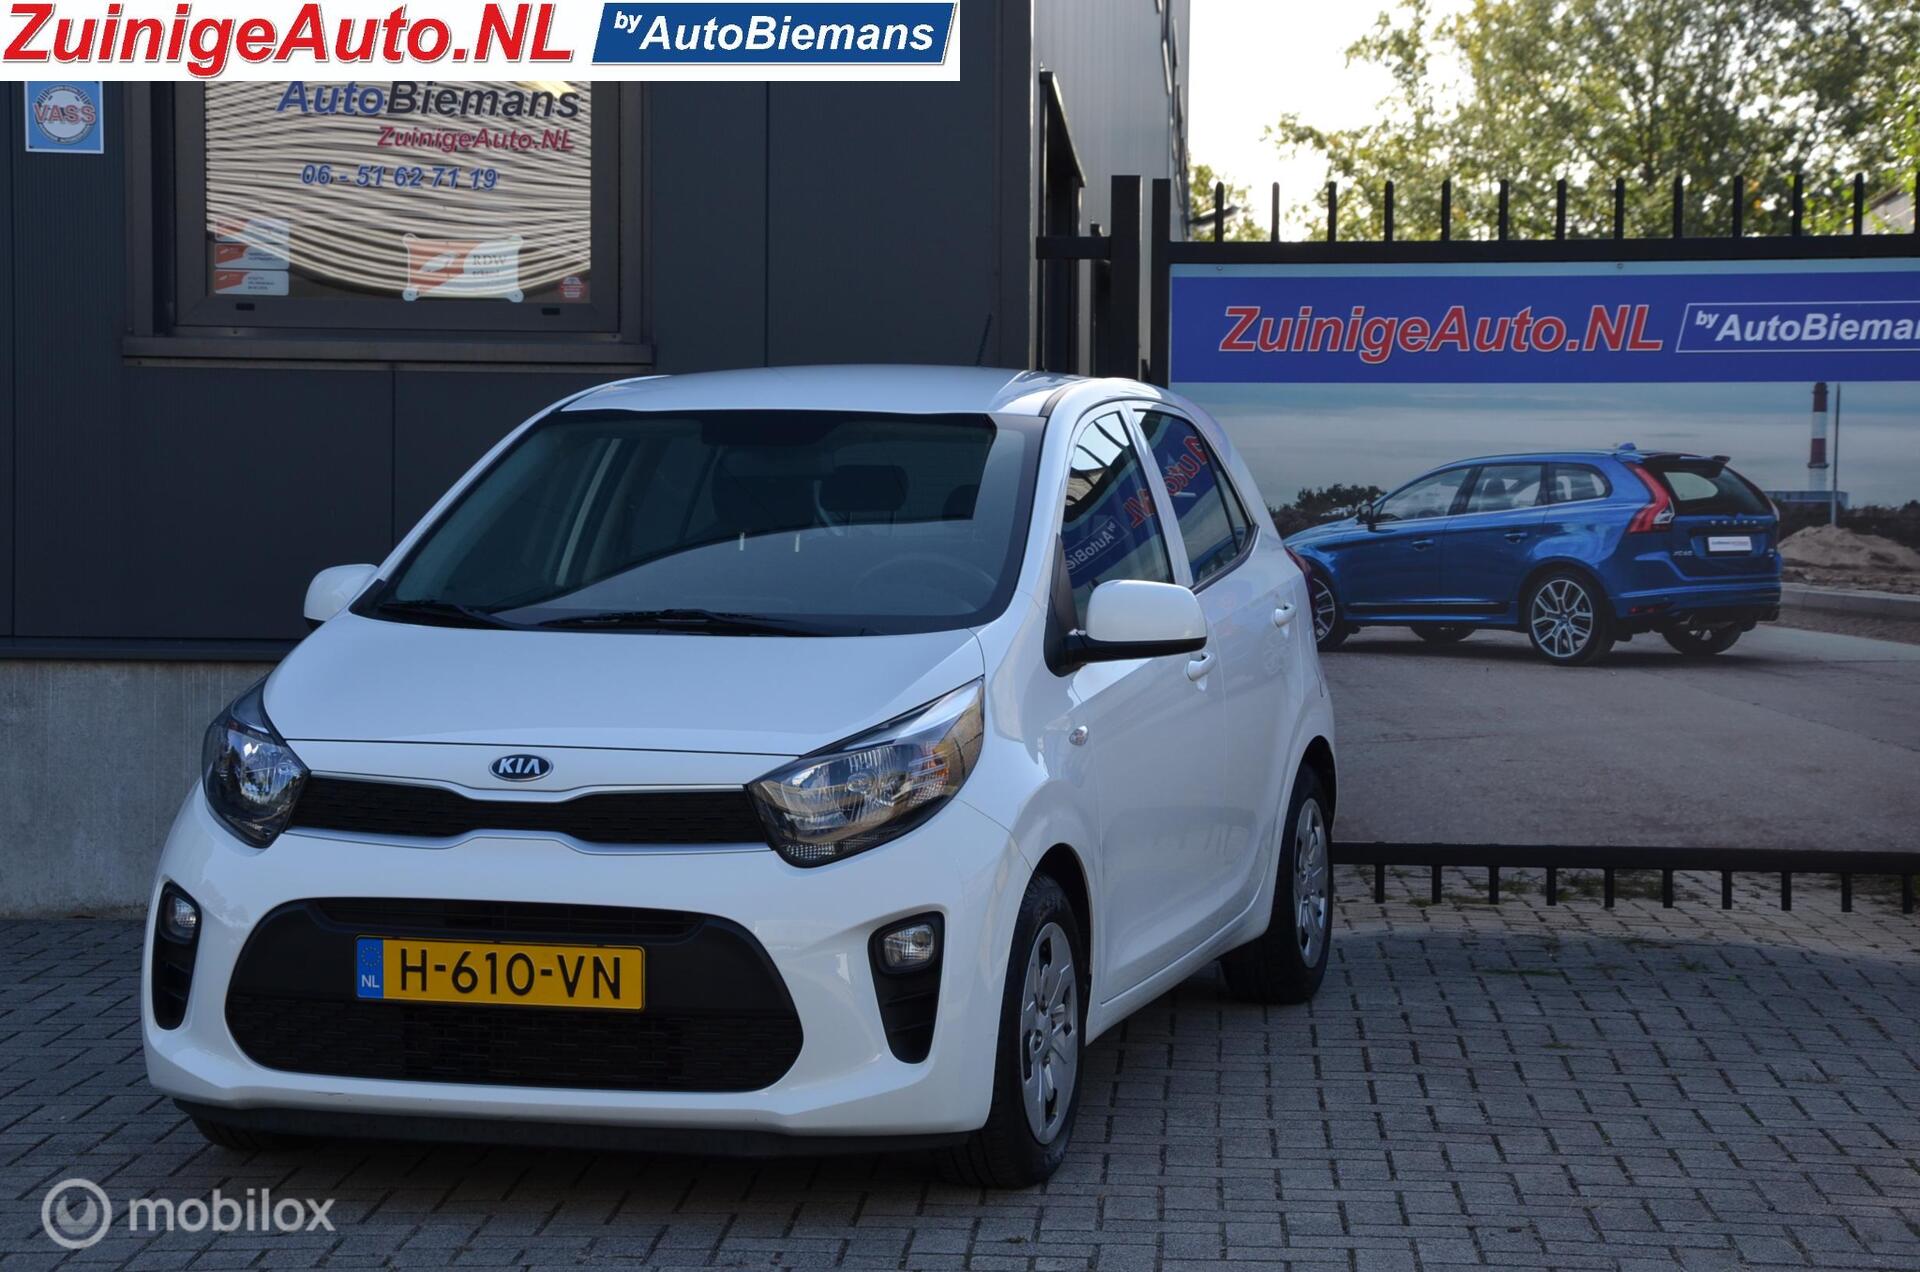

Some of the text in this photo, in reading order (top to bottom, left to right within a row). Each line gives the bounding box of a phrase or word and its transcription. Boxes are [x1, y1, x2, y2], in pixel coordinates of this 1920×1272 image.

[276, 81, 580, 117] AutoBiemans
[32, 103, 97, 125] VASS
[376, 125, 576, 153] ZuinigeAuto.NL
[301, 164, 332, 185] 06
[355, 166, 385, 187] 51
[393, 167, 423, 187] 62
[431, 167, 460, 188] 71
[469, 168, 498, 190] 19
[1218, 304, 1920, 364] ZuinigeAuto.NL by AutoBiema
[498, 757, 541, 775] KIA
[361, 948, 621, 1000] NL H-610-VN
